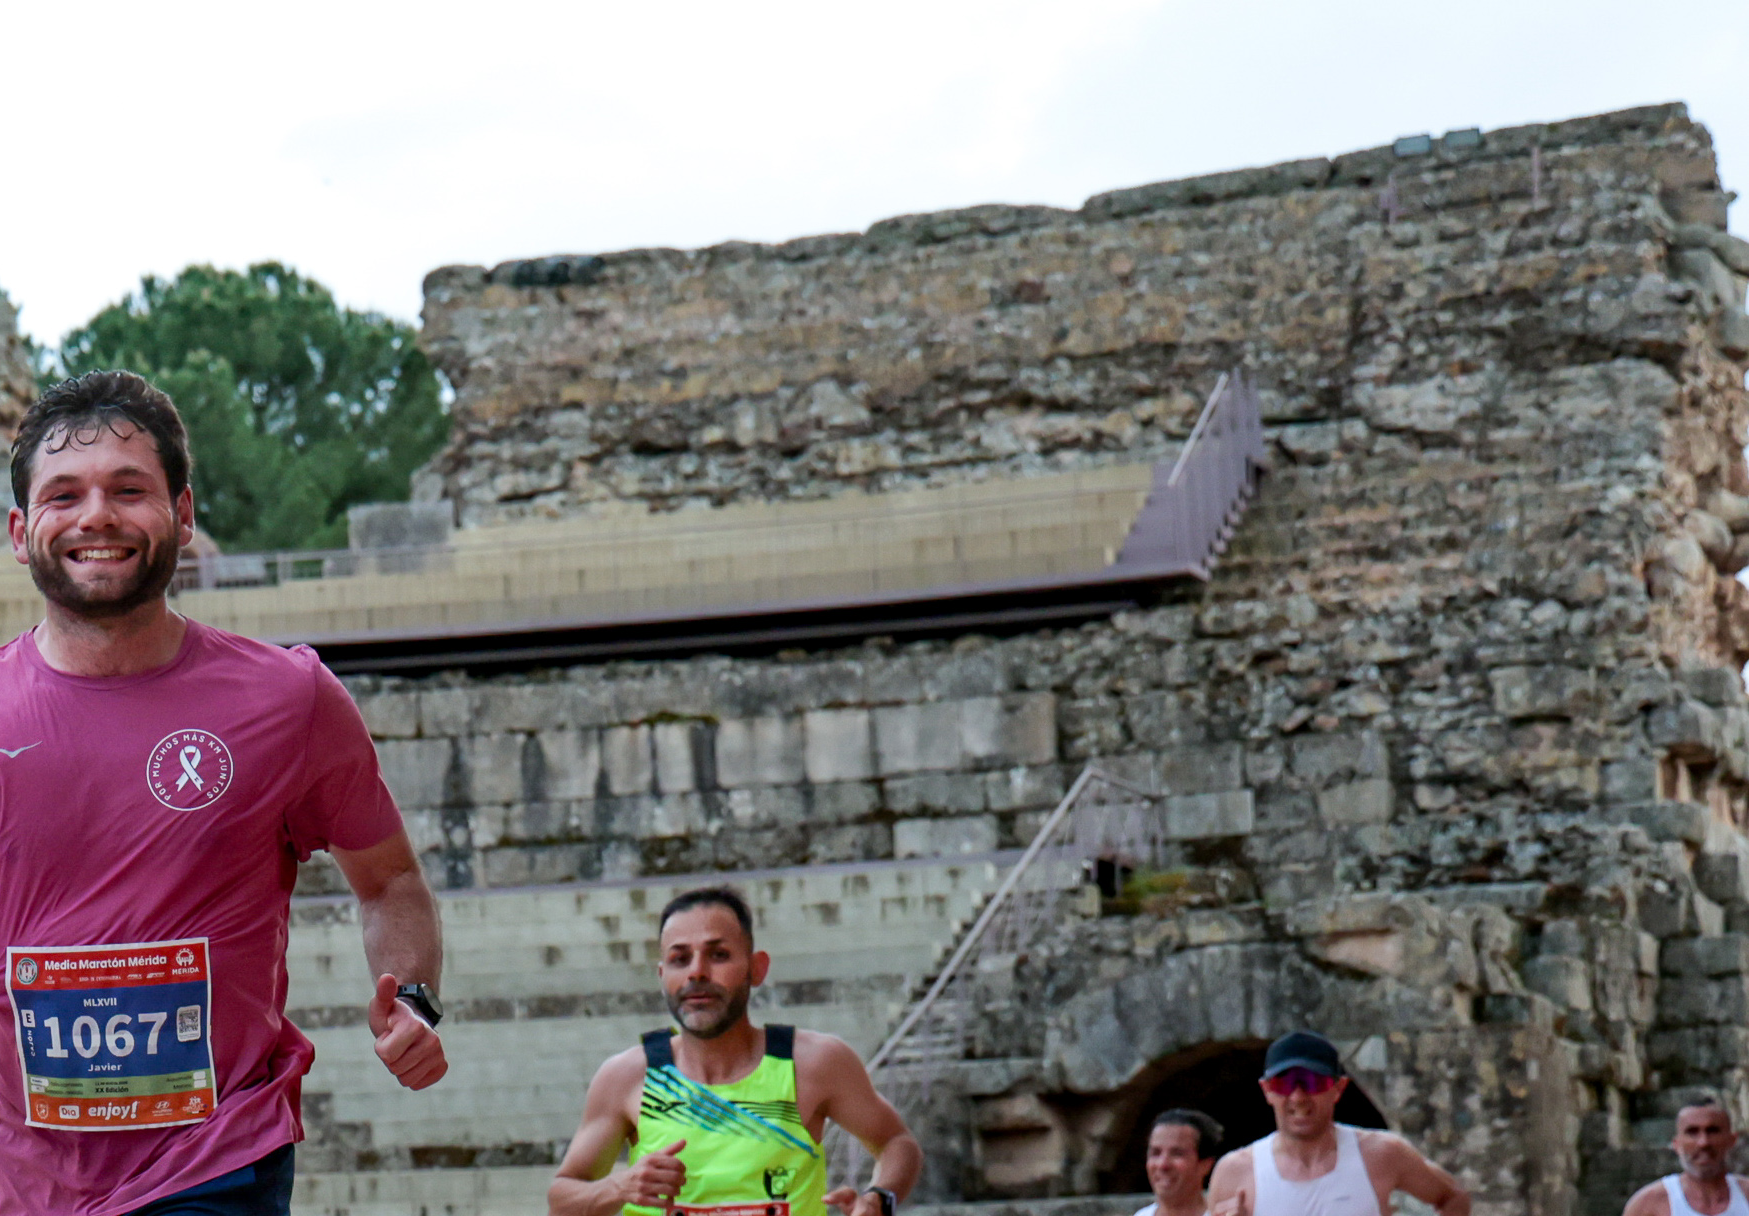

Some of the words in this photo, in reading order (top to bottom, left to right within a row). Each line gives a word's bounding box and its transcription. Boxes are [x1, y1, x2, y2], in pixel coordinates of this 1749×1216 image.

[183, 732, 205, 742] MÁS
[208, 741, 222, 754] KM
[152, 738, 179, 777] MUCHOS
[206, 758, 228, 799] JUNTOS
[154, 781, 171, 800] POR
[44, 958, 77, 971] Media
[79, 956, 125, 969] Maratón
[128, 954, 167, 967] Mérida
[83, 998, 117, 1007] MLXVII
[25, 1013, 32, 1023] E
[44, 1012, 168, 1059] 1067
[88, 1063, 122, 1072] Javier
[88, 1101, 138, 1120] enjoy!
